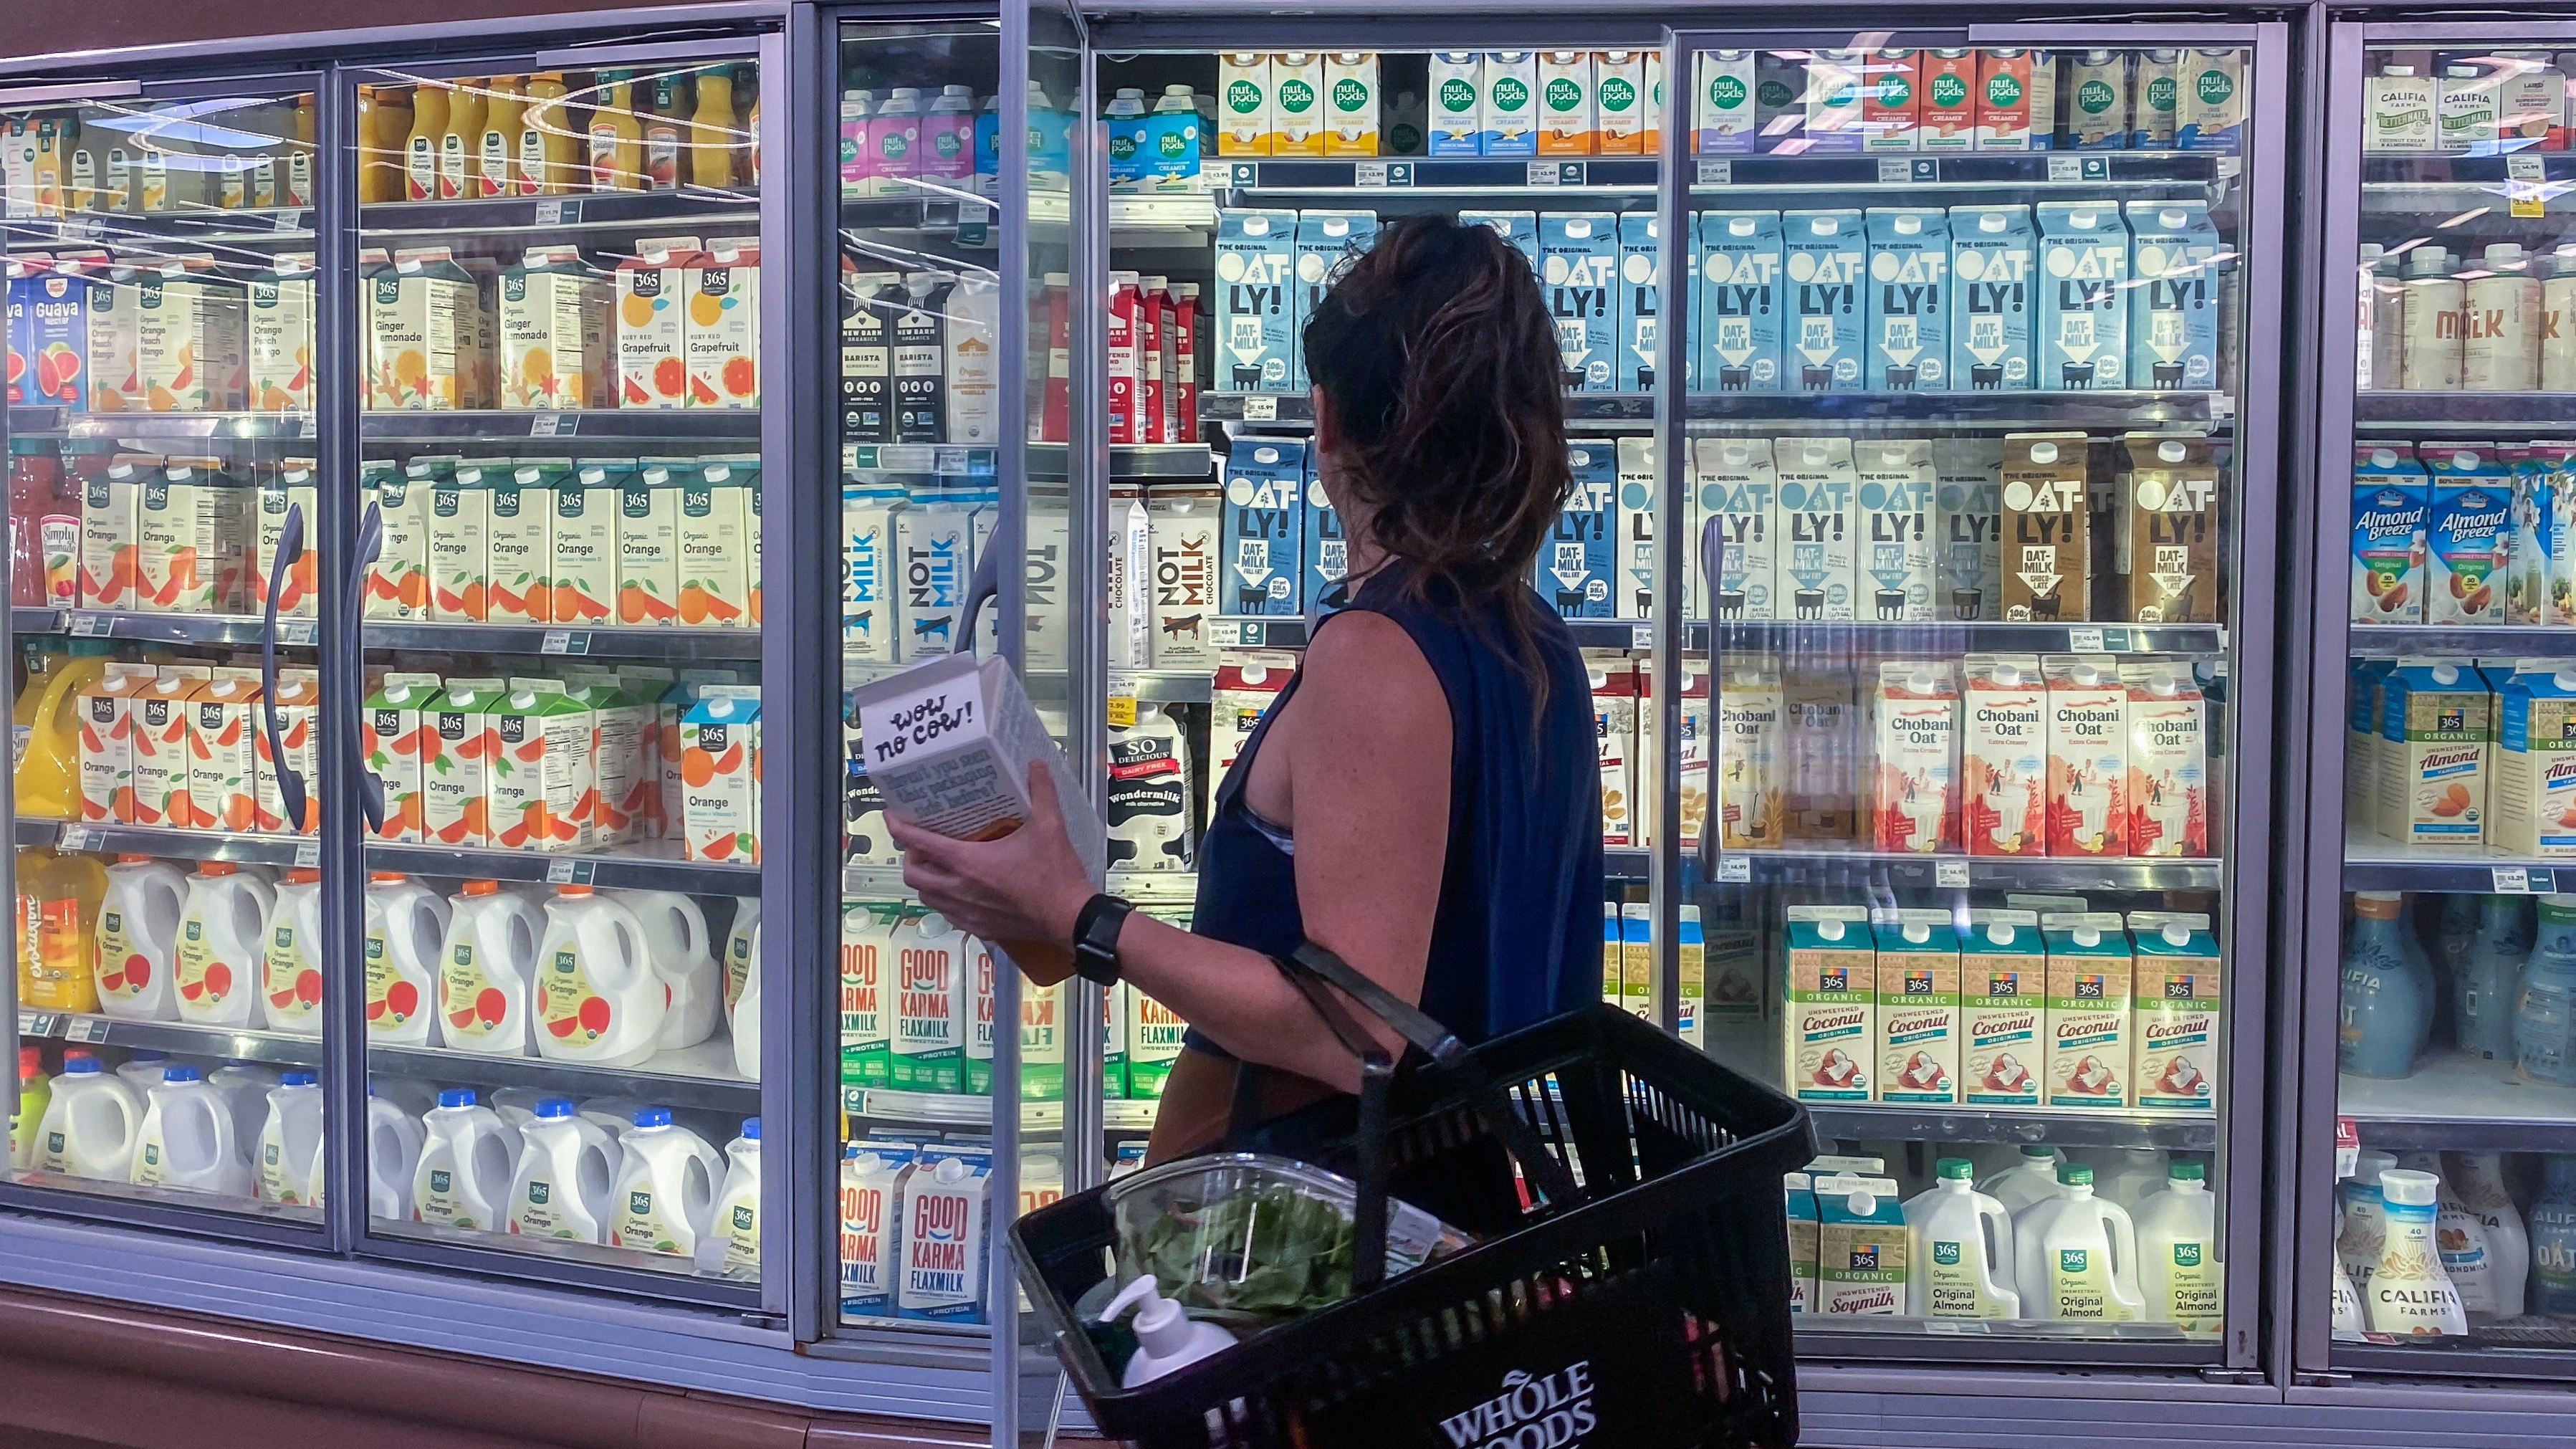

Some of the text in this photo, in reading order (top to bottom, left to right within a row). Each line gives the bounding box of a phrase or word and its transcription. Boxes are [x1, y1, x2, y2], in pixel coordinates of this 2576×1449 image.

[1337, 83, 1356, 92] nut
[1935, 78, 1954, 88] nut
[1337, 89, 1365, 104] pods
[1935, 83, 1964, 100] pods
[2381, 92, 2426, 102] CALIFIA
[2444, 94, 2490, 103] CALIFIA
[2406, 110, 2428, 123] HALF
[1162, 134, 1177, 144] nut
[1162, 140, 1185, 152] pods
[1705, 253, 1780, 284] OAT-
[1872, 252, 1947, 282] OAT-
[2046, 247, 2125, 278] OAT-
[507, 279, 524, 292] 365
[1554, 288, 1606, 317] LY!
[1884, 284, 1938, 314] LY!
[36, 302, 78, 317] Guava
[505, 320, 531, 330] Ginger
[1237, 325, 1256, 336] OAT-
[622, 343, 670, 354] Grapefruit
[690, 343, 739, 353] Grapefruit
[1234, 337, 1258, 350] MILK
[1722, 338, 1747, 350] MILK
[140, 348, 164, 356] Mango
[89, 487, 107, 499] 365
[2004, 481, 2083, 512] OAT-
[436, 494, 457, 507] 365
[625, 494, 646, 507] 365
[1238, 509, 1288, 538] LY!
[2355, 507, 2423, 530] Almond
[44, 527, 75, 542] Simply
[2017, 513, 2072, 543] LY!
[2368, 523, 2413, 541] Breeze
[2452, 525, 2496, 542] Breeze
[87, 530, 117, 540] Orange
[557, 531, 581, 540] Organic
[494, 543, 529, 555] Orange
[623, 544, 660, 555] Orange
[1244, 543, 1263, 555] OAT-
[1242, 556, 1265, 568] MILK
[2024, 561, 2052, 573] MILK
[932, 532, 959, 607] MILK
[909, 547, 929, 607] NOT
[1158, 547, 1179, 606] NOT
[148, 703, 165, 717] 365
[889, 695, 947, 731] wow
[2057, 709, 2119, 723] Chobani
[502, 719, 522, 732] 365
[874, 701, 972, 762] no cow!
[1735, 722, 1760, 735] Oat
[1892, 718, 1953, 732] Chobani
[2075, 723, 2102, 736] Oat
[1910, 732, 1936, 745] Oat
[1127, 740, 1157, 755] SO
[2426, 745, 2474, 753] UNSWEETENED
[1119, 752, 1167, 763] DELICIOUS
[2420, 750, 2479, 770] Almond
[85, 762, 115, 774] Orange
[1122, 762, 1167, 775] DAIRY FREE
[193, 769, 223, 781] Orange
[430, 781, 464, 793] Orange
[1109, 790, 1180, 803] Wondermilk
[557, 955, 574, 966] 365
[901, 950, 949, 991] GOOD
[450, 975, 474, 987] Orange
[1993, 980, 2014, 993] 365
[901, 993, 949, 1018] KARMA
[1976, 998, 2032, 1006] ORGANIC
[1893, 1009, 1944, 1018] UNSWEETENED
[1803, 1012, 1864, 1030] Coconut
[1972, 1016, 2034, 1036] Coconut
[901, 1019, 949, 1038] FLAXMILK
[1141, 1026, 1185, 1043] FLAXMIL
[2057, 1019, 2120, 1038] Coconut
[1903, 1032, 1934, 1041] ORIGINAL
[632, 1195, 648, 1208] 365
[426, 1205, 452, 1216] Orange
[914, 1195, 968, 1240] GOOD
[625, 1227, 653, 1238] Orange
[913, 1243, 964, 1271] KARMA
[2177, 1245, 2197, 1258] 365
[1854, 1253, 1874, 1267] 365
[911, 1270, 964, 1292] FLAXMILK
[1933, 1270, 1960, 1280] Organic
[1933, 1288, 1975, 1301] Original
[2175, 1290, 2217, 1301] Original
[2380, 1289, 2456, 1305] CALIFIA
[1830, 1292, 1895, 1314] Soymilk
[1933, 1301, 1975, 1310] Almond
[2175, 1301, 2217, 1310] Almond
[1440, 1359, 1595, 1448] WHOLE
[1485, 1397, 1596, 1449] OODS
